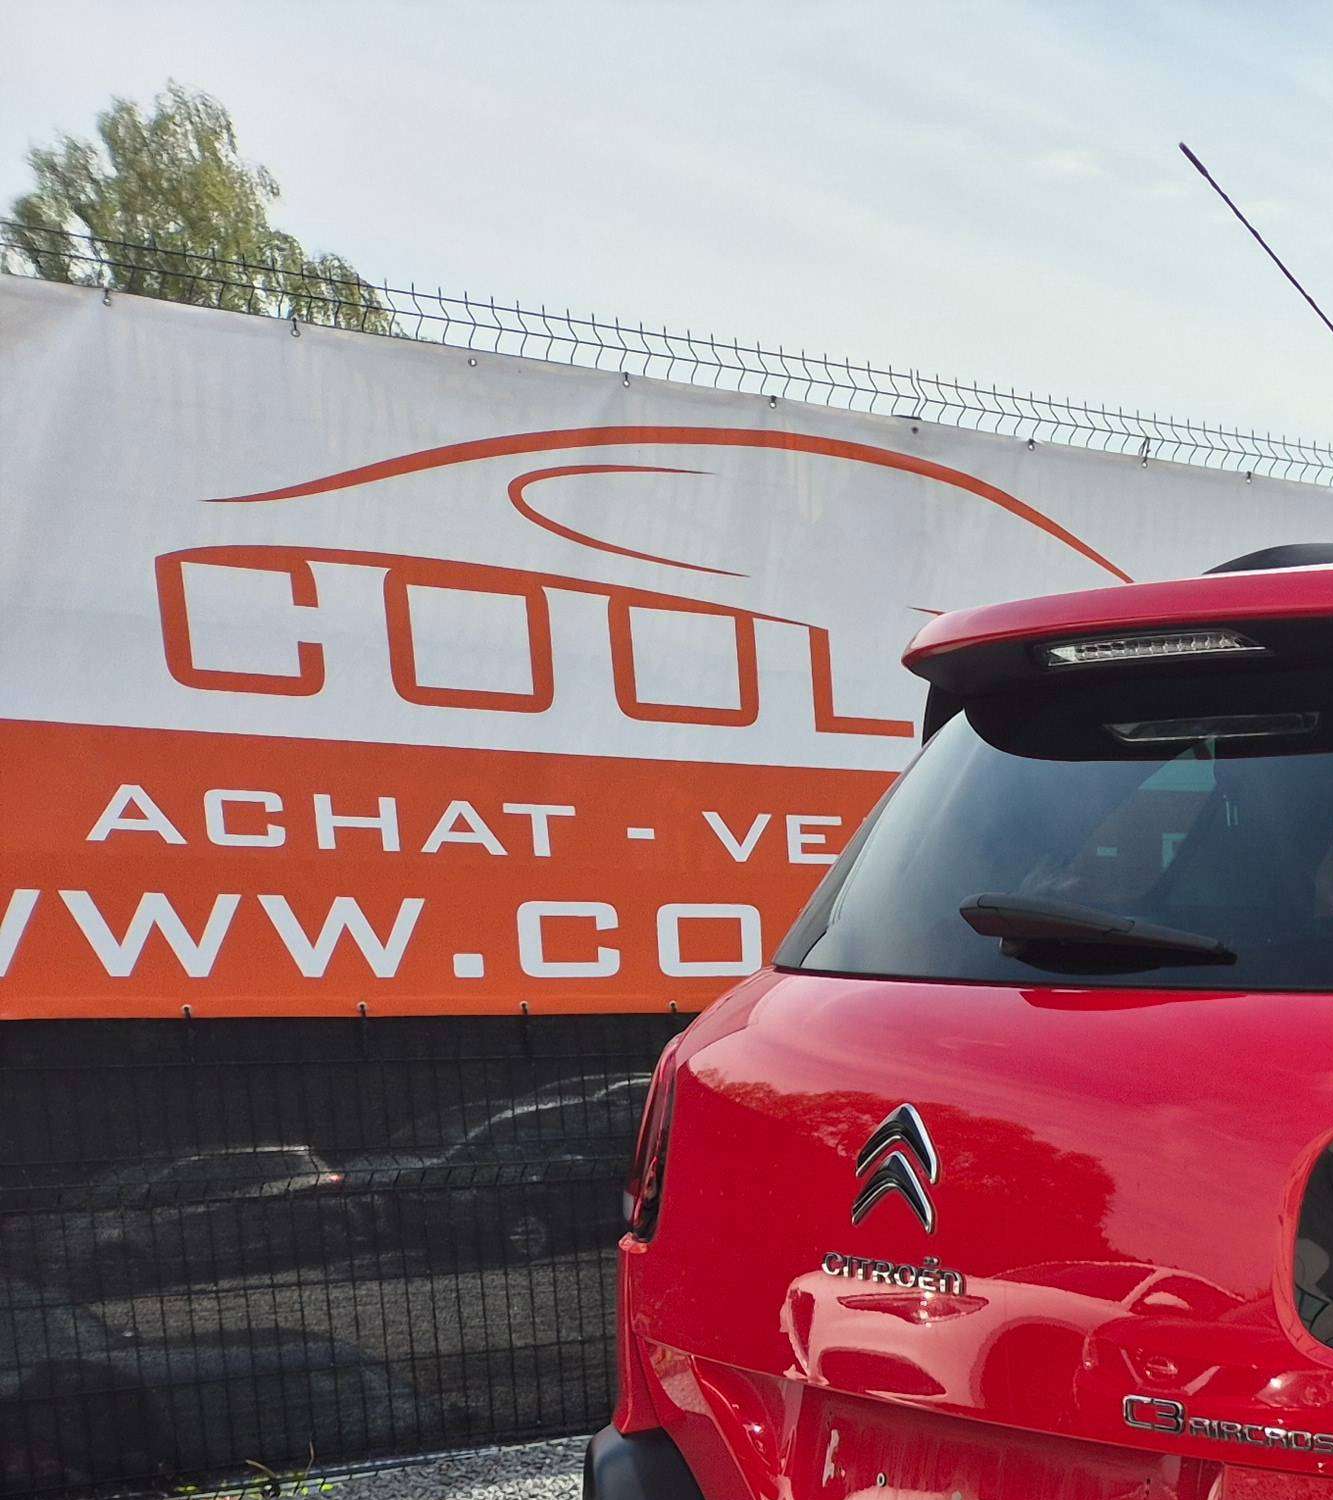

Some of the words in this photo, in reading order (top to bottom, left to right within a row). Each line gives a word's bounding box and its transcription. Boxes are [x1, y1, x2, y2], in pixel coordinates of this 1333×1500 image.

[154, 545, 915, 738] COOL
[86, 783, 576, 858] ACHAT
[627, 827, 655, 840] -
[822, 1252, 967, 1296] CITROËN
[1122, 1394, 1185, 1434] C3
